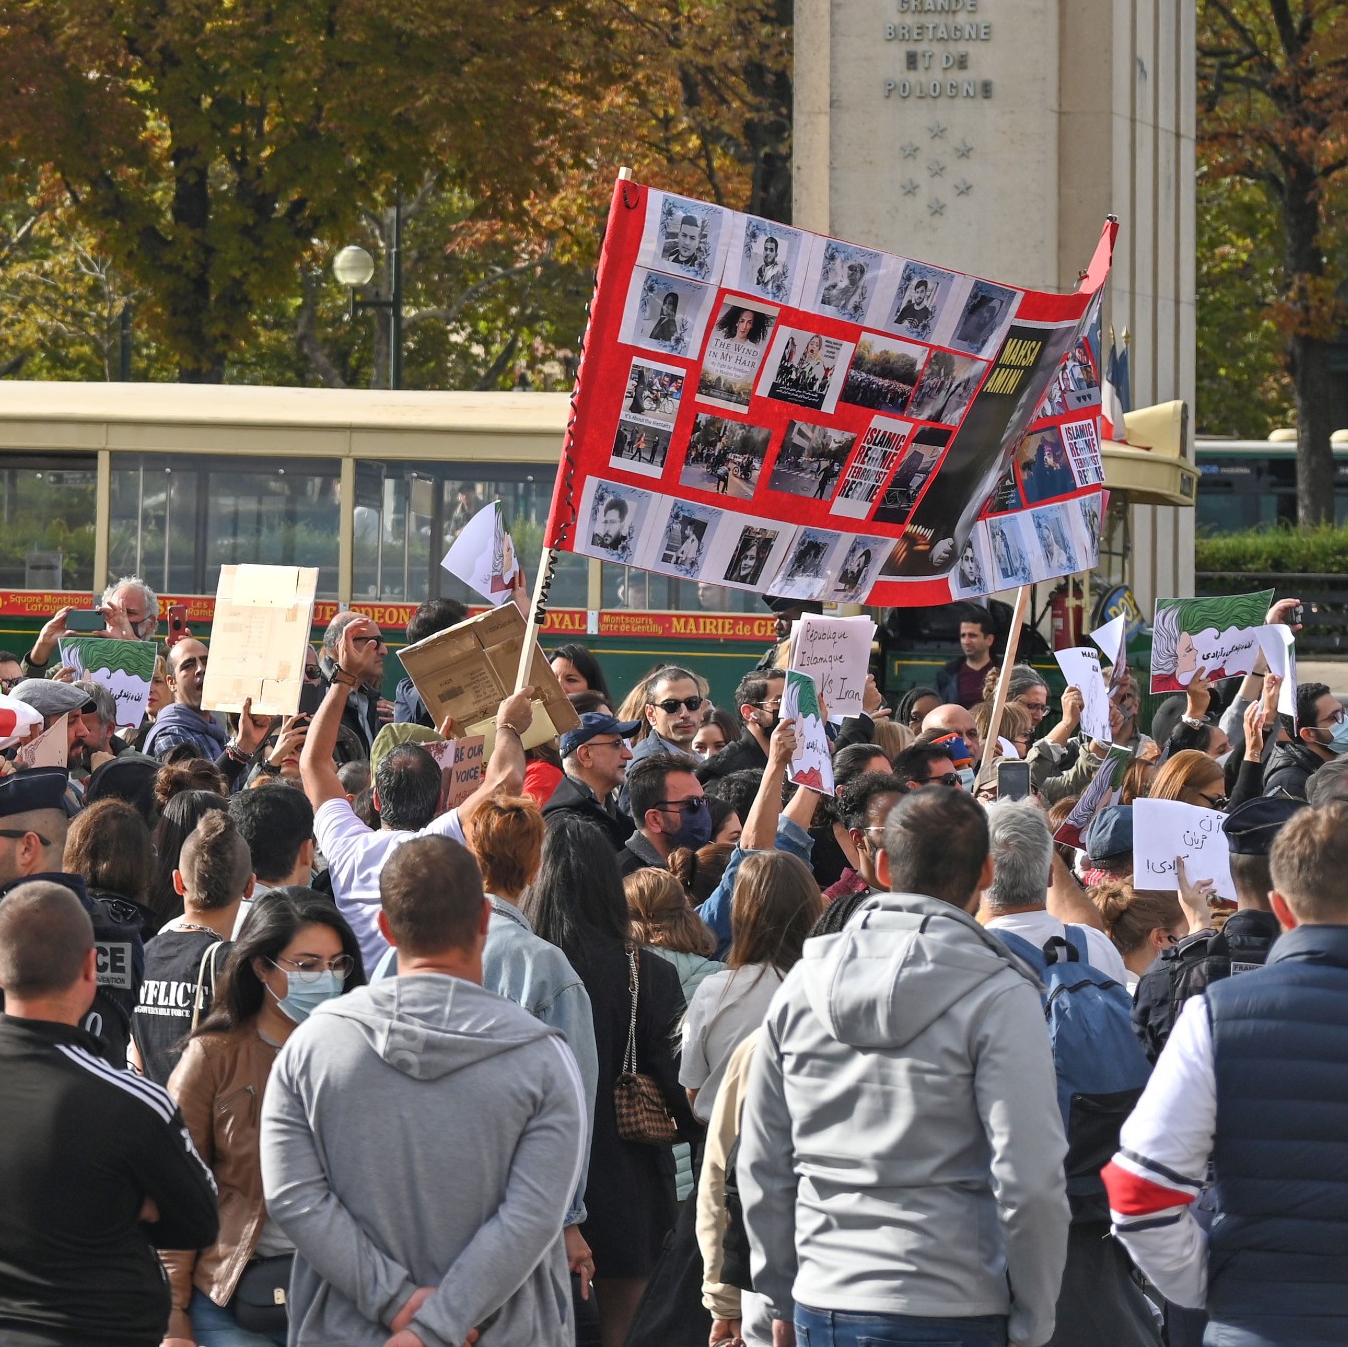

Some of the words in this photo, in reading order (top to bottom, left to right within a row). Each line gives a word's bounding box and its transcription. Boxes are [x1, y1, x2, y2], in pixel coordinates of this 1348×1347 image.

[885, 22, 991, 41] BRETAGNE
[906, 51, 933, 70] ET
[942, 52, 968, 70] DE
[884, 80, 993, 99] POLOGNE
[714, 338, 732, 350] THE
[999, 338, 1043, 367] MAHSA
[735, 355, 756, 369] HAIR
[983, 368, 1024, 394] AMINI
[863, 426, 907, 452] ISLAMIC
[1065, 422, 1094, 440] ISLAMIC
[854, 444, 899, 471] REGIME
[9, 594, 42, 605] Square
[541, 612, 587, 631] OYAL
[603, 614, 654, 624] Montsouris
[671, 616, 734, 635] MAIRIE
[735, 621, 752, 636] de
[620, 623, 630, 632] de
[631, 623, 663, 635] Gentilly
[805, 622, 848, 650] République
[799, 652, 845, 671] Islamique
[836, 677, 861, 702] Iran
[455, 746, 465, 763] BE
[467, 744, 484, 759] OUR
[456, 766, 479, 783] VOICE
[139, 980, 209, 1010] NFLICT
[171, 1008, 191, 1018] FORCE
